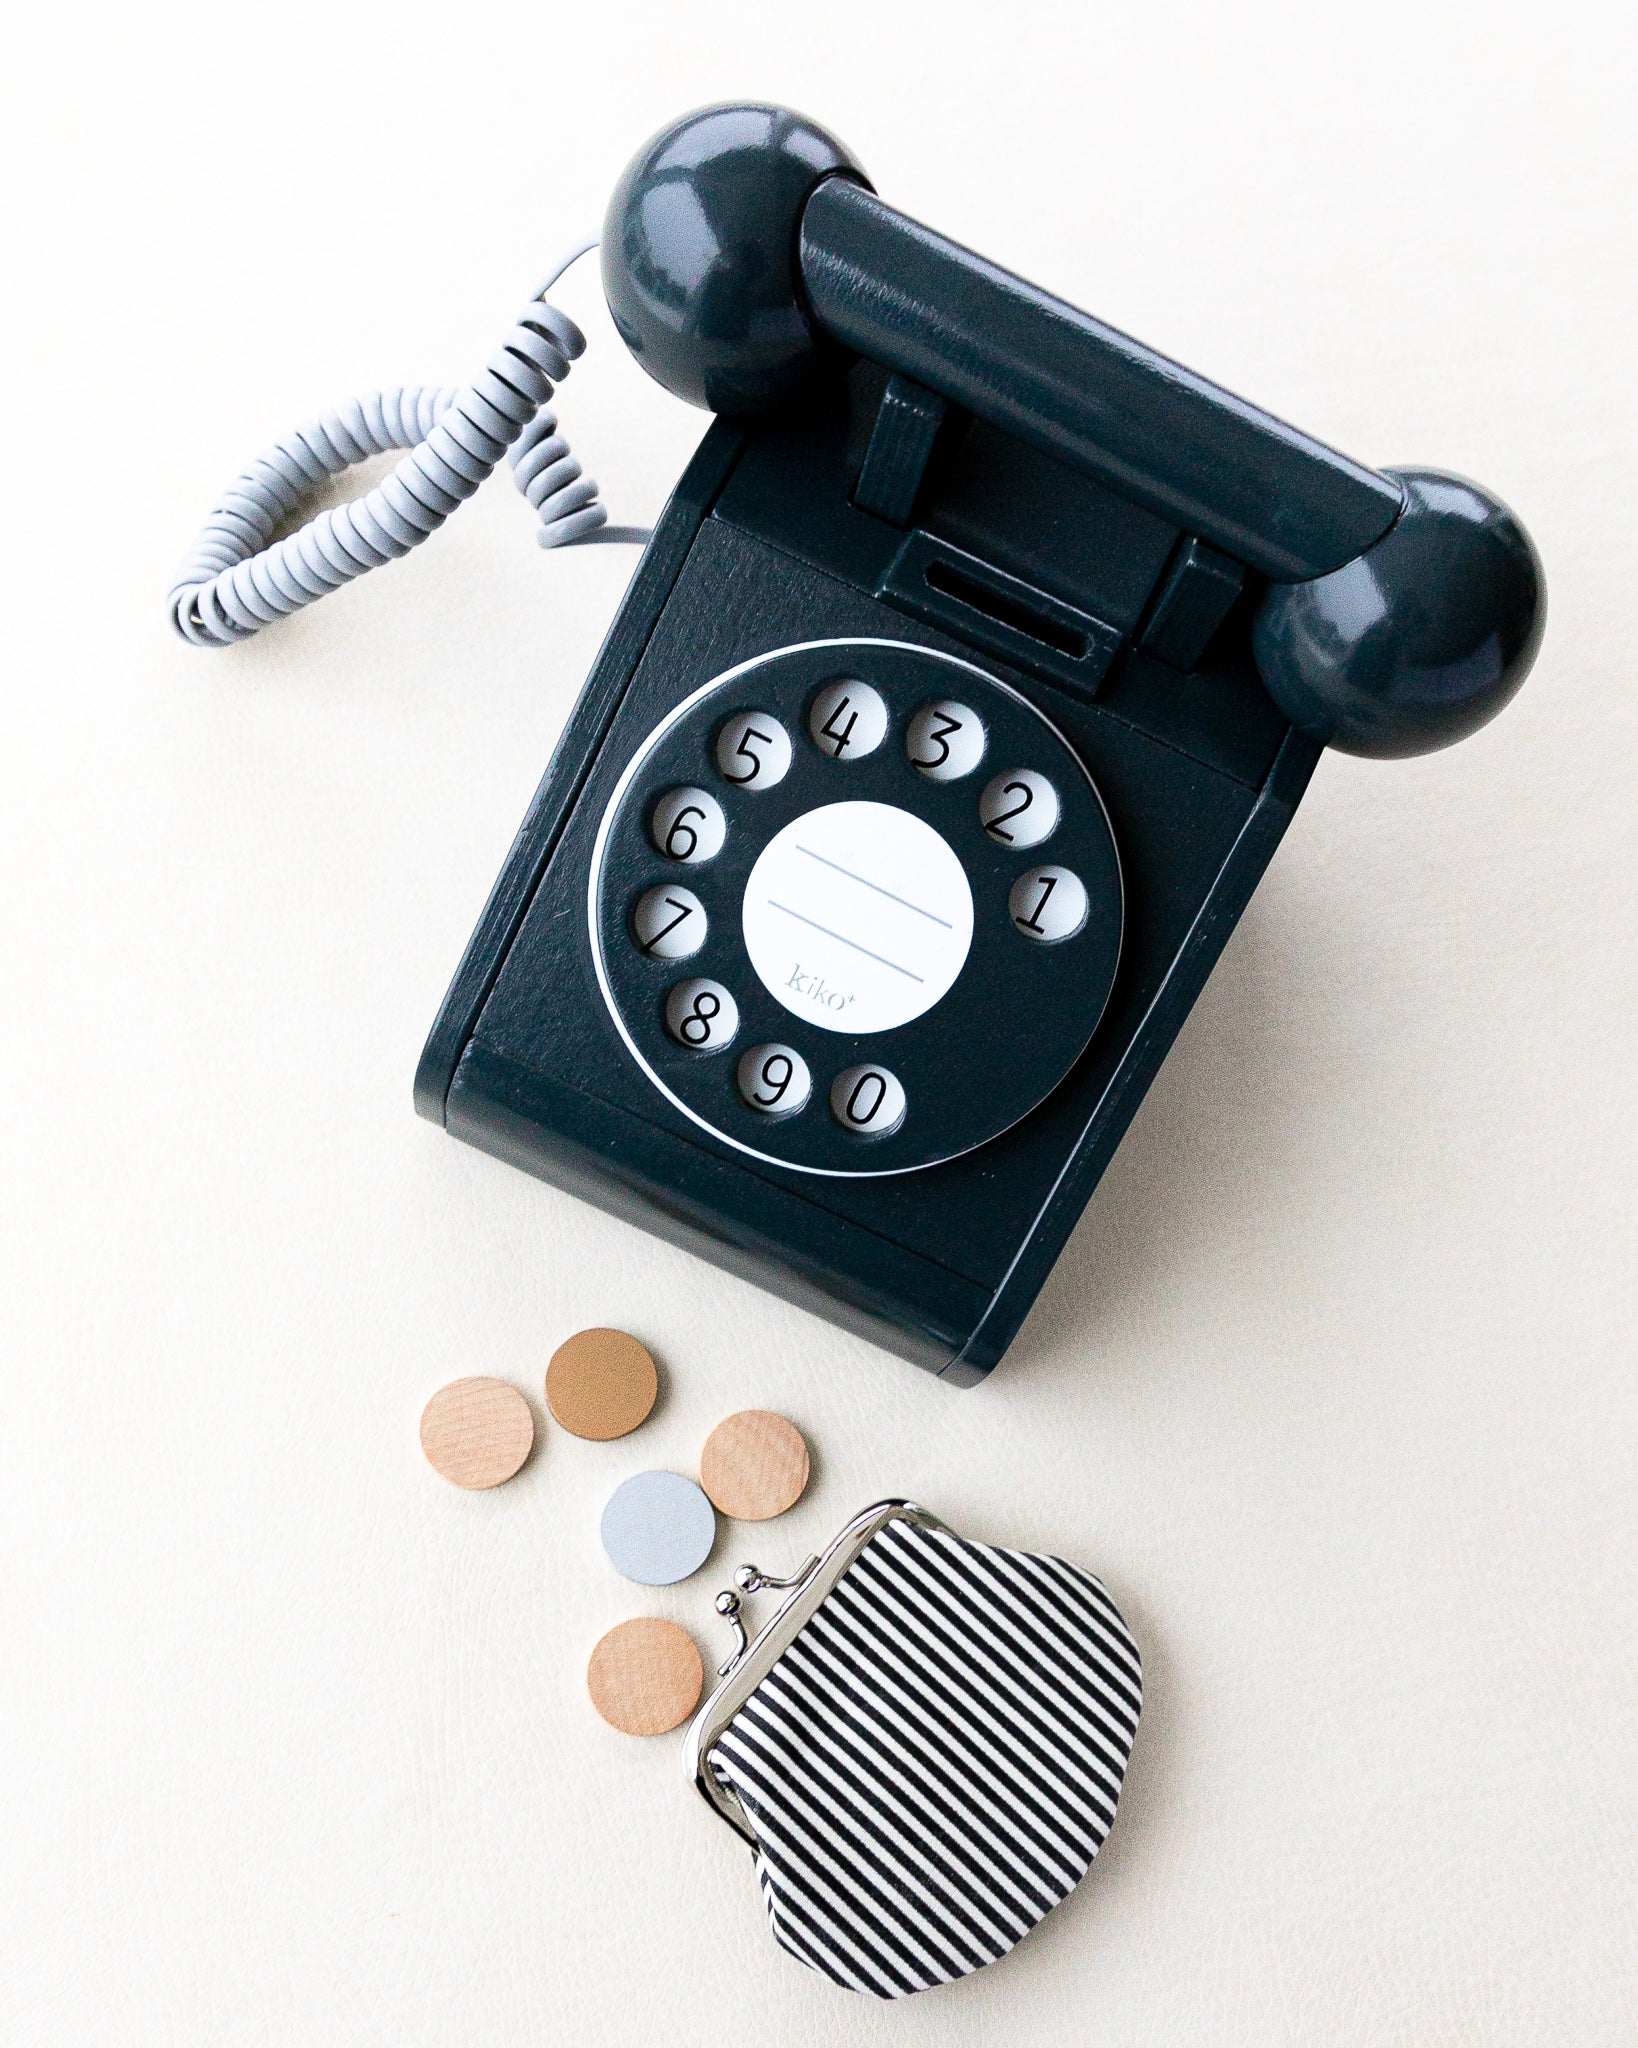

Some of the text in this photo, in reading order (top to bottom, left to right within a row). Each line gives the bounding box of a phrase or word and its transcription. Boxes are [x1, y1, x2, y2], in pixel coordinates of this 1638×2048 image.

[820, 696, 859, 757] 4
[910, 711, 963, 769] 3
[723, 727, 773, 784] 5
[665, 805, 707, 861] 6
[983, 781, 1034, 842] 2
[642, 897, 693, 952] 7
[1015, 876, 1059, 934] 1
[680, 991, 721, 1045] 8
[752, 1054, 794, 1106] 9
[846, 1072, 887, 1125] 0
